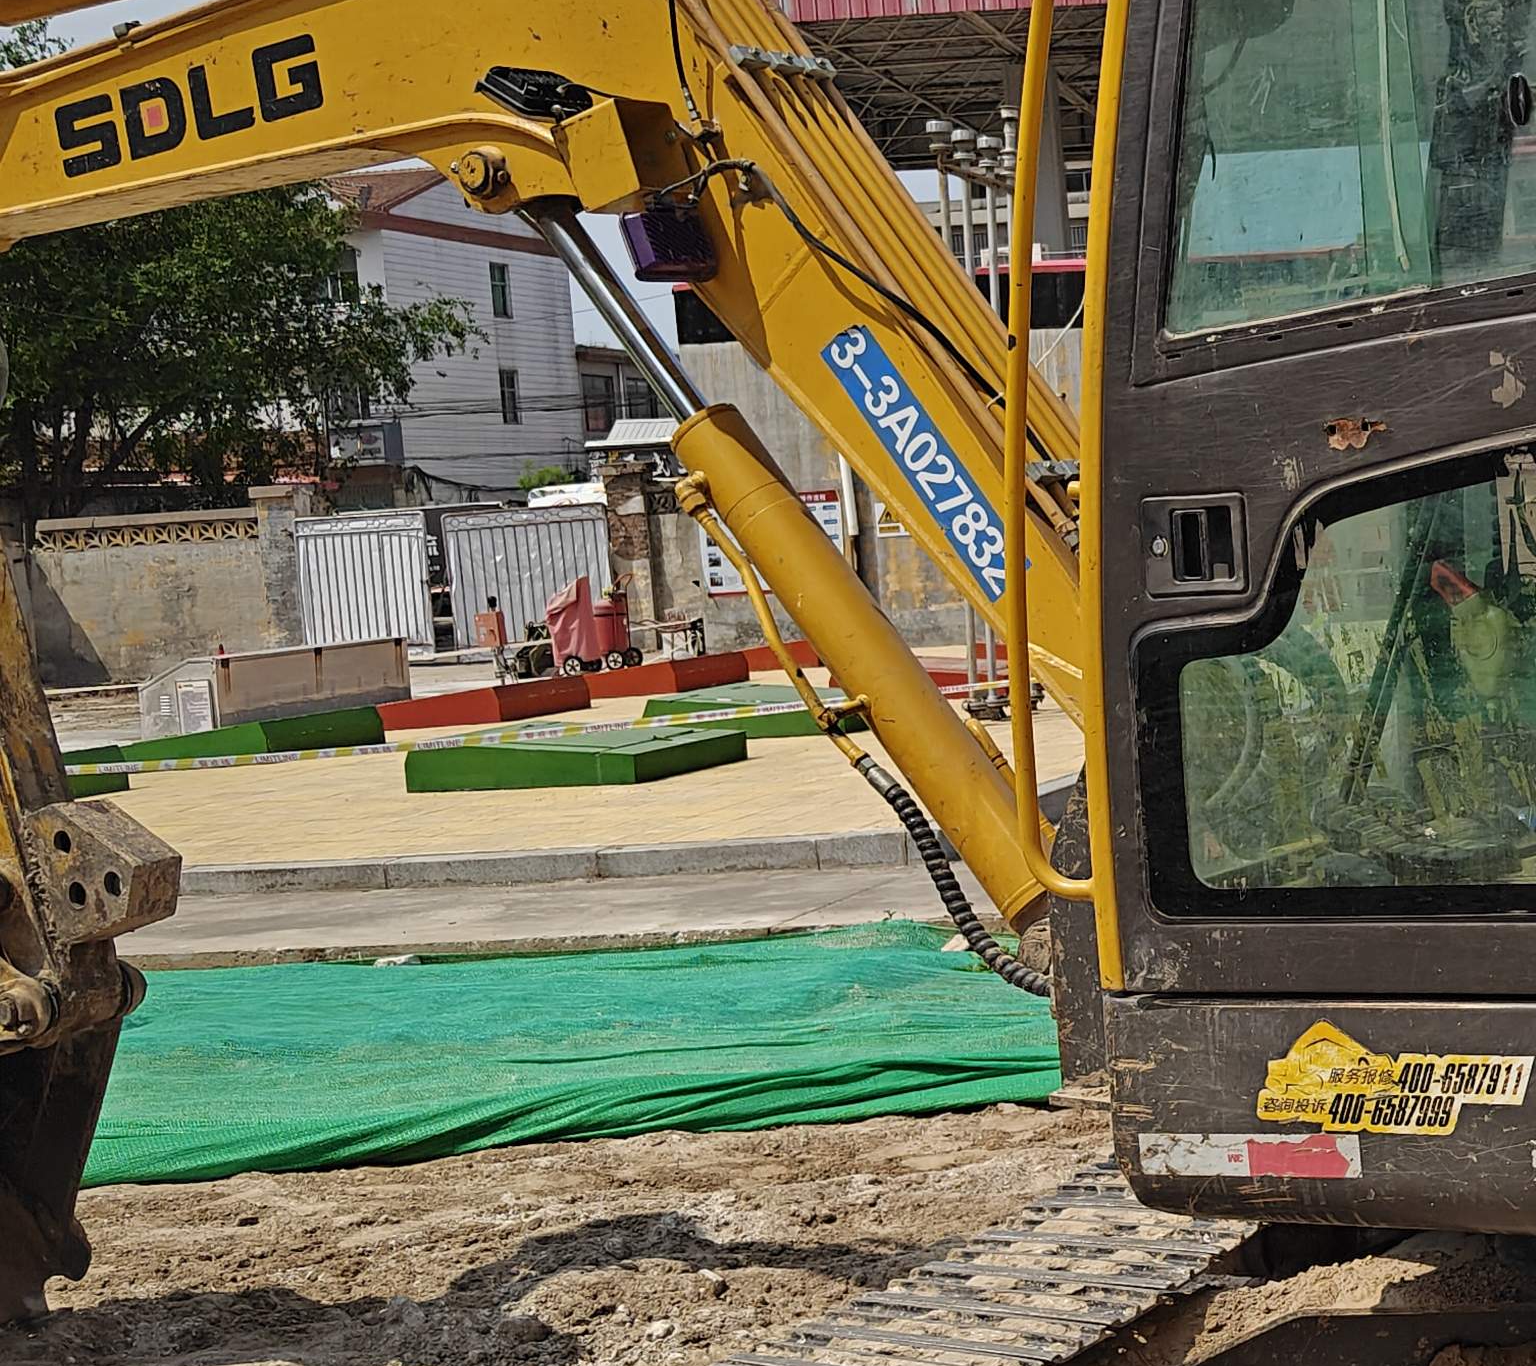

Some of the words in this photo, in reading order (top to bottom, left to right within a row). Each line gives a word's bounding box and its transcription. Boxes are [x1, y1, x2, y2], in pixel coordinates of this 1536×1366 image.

[54, 34, 324, 178] SDLG
[1328, 1068, 1394, 1085] 服务报修
[1399, 1063, 1525, 1095] 400-6587911
[1264, 1098, 1326, 1113] 咨询投诉
[1329, 1093, 1454, 1127] 400-6587999
